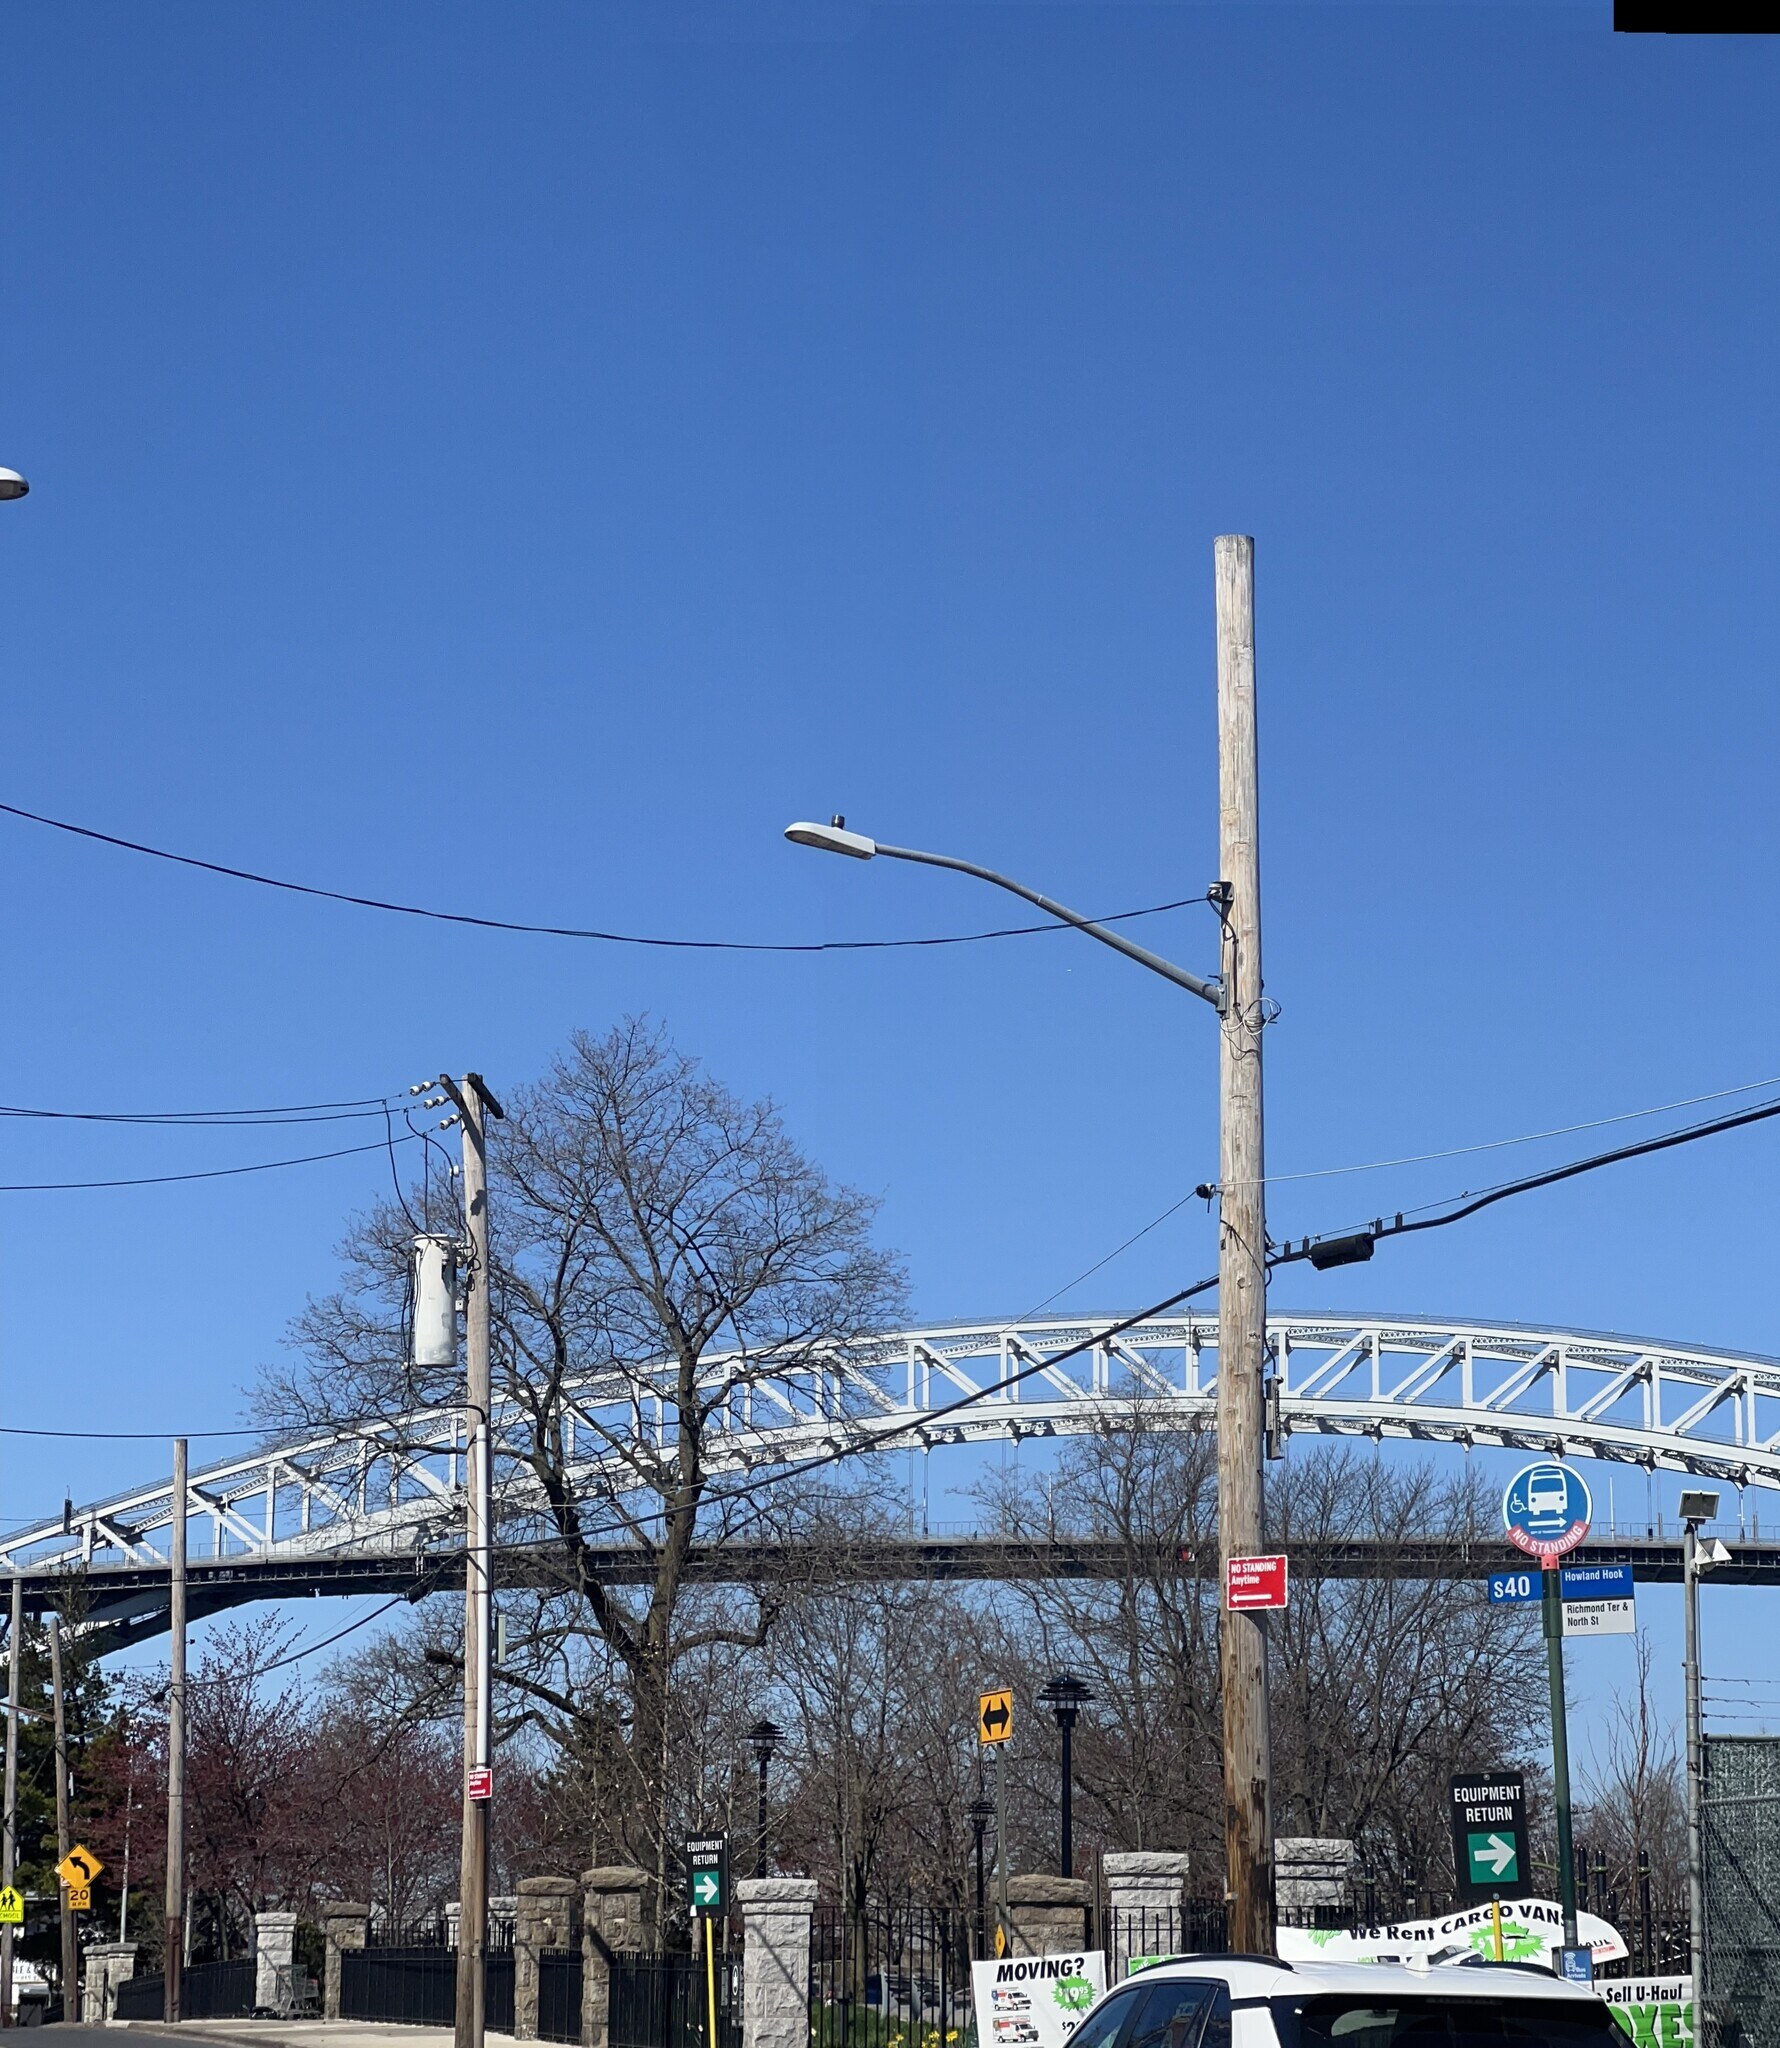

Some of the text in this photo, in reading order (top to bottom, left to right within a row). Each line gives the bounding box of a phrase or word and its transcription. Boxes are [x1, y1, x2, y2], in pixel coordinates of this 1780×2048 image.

[1512, 1525, 1583, 1554] NO STANDING
[1231, 1561, 1277, 1573] NO STANDING
[1231, 1574, 1260, 1587] Anytime
[1564, 1569, 1624, 1582] Howland Hook
[1493, 1576, 1531, 1598] S40
[1566, 1602, 1629, 1614] Richmond Ter &
[1567, 1616, 1600, 1627] North St
[1453, 1785, 1521, 1803] EQUIPMENT
[1465, 1806, 1513, 1823] RETURN
[686, 1840, 724, 1853] EQUIPMENT
[692, 1853, 719, 1866] RETURN
[70, 1889, 89, 1901] 20
[1349, 1927, 1381, 1941] We
[1387, 1926, 1435, 1942] Rent
[1440, 1905, 1514, 1935] CARGO
[996, 1957, 1085, 1983] MOVING?
[1606, 1986, 1631, 2003] Sell
[1636, 1984, 1683, 2001] U-Haul
